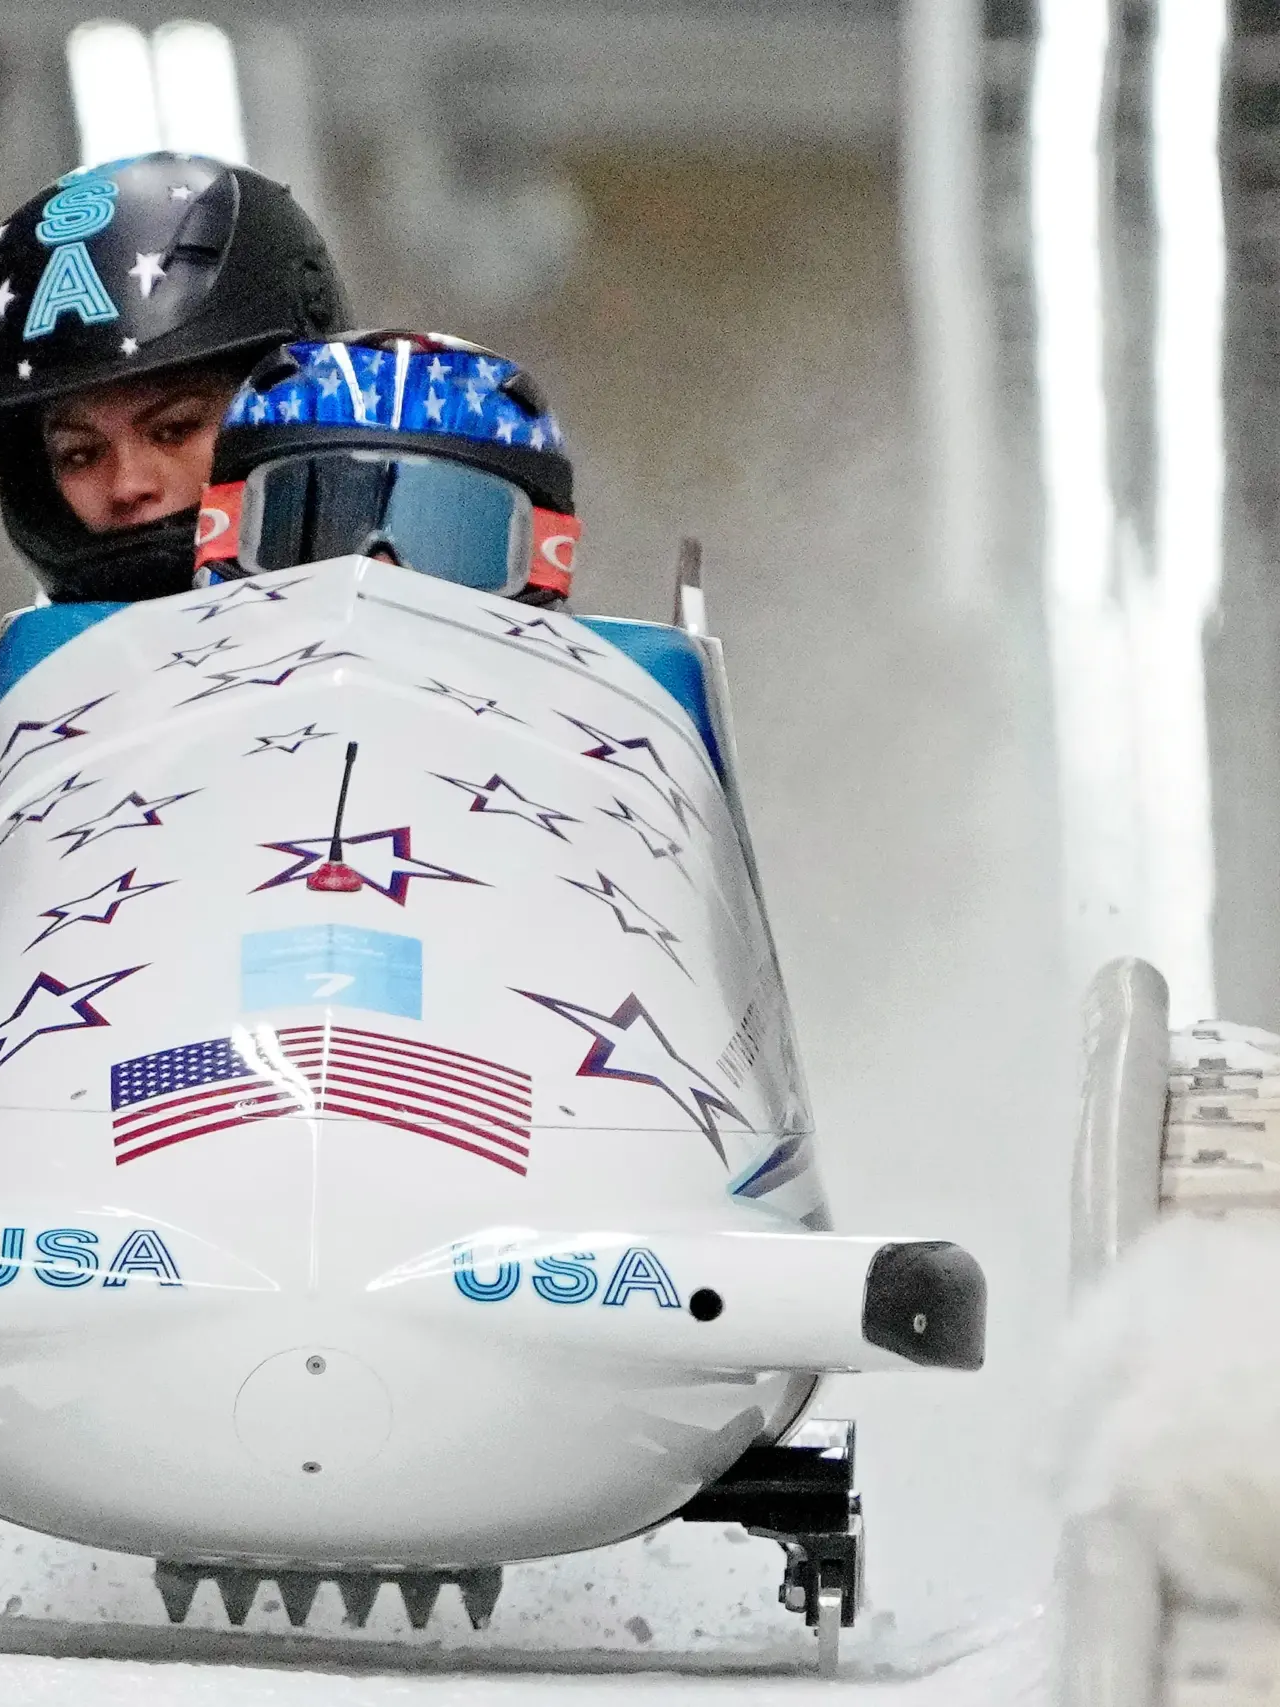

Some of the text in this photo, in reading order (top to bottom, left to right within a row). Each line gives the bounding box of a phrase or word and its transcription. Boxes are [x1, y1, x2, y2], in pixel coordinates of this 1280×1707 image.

[23, 165, 122, 341] SA
[305, 972, 357, 999] 7
[453, 1243, 682, 1308] USA
